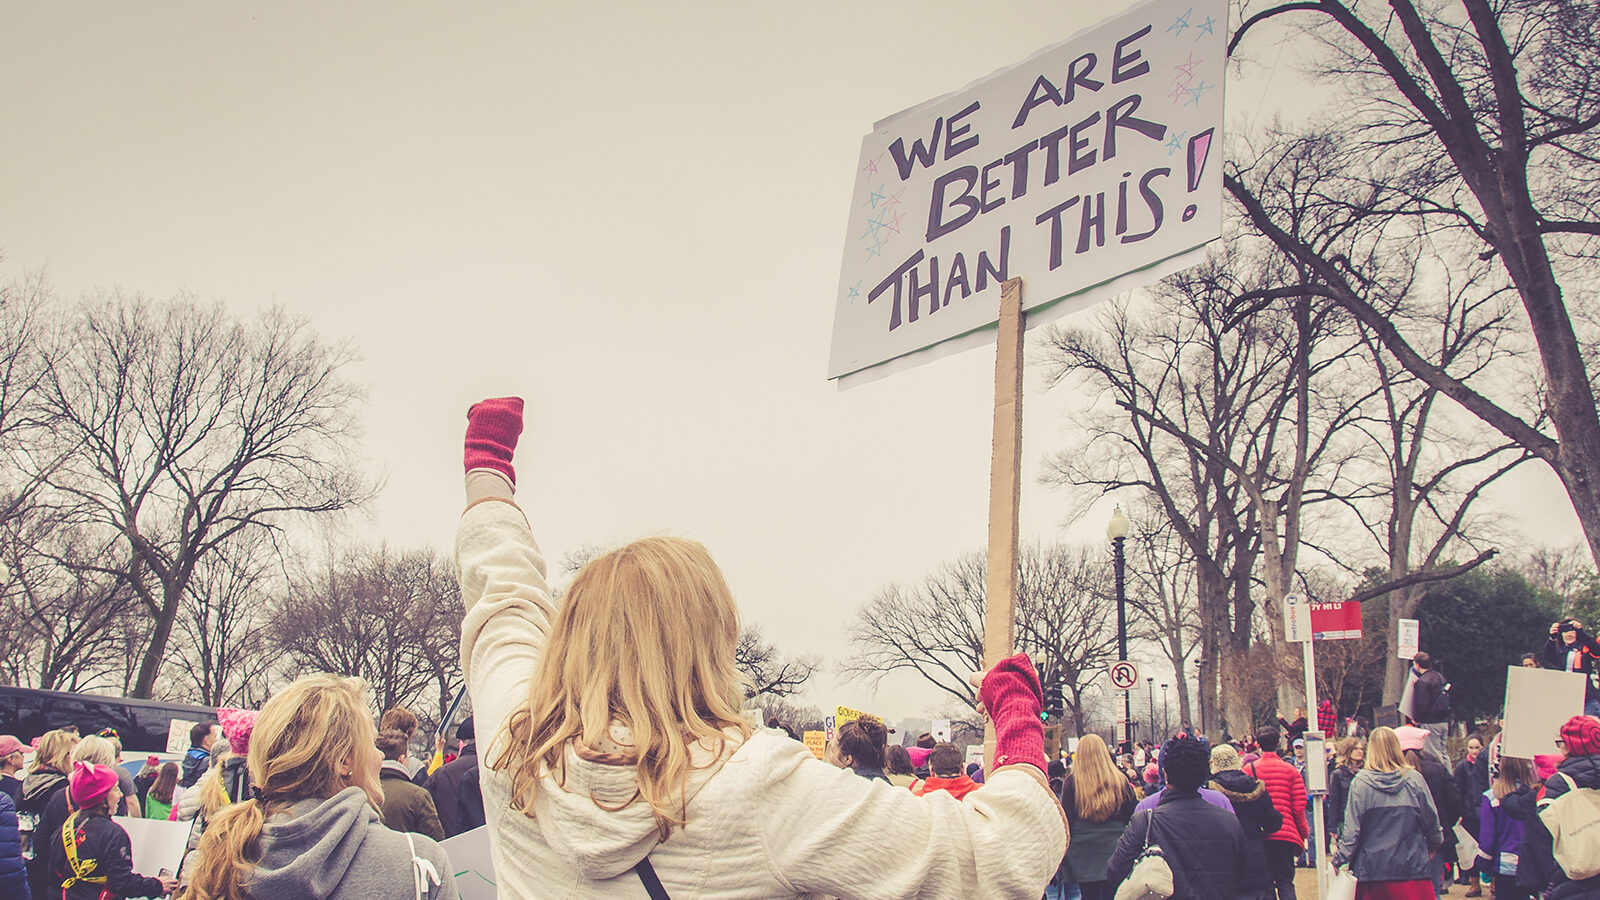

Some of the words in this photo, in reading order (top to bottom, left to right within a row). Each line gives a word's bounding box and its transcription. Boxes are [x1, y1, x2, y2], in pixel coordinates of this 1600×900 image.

[888, 101, 981, 181] WE
[1011, 24, 1152, 129] ARE
[926, 94, 1168, 243] BETTER
[868, 225, 1011, 332] THAN
[1035, 127, 1215, 271] THIS!
